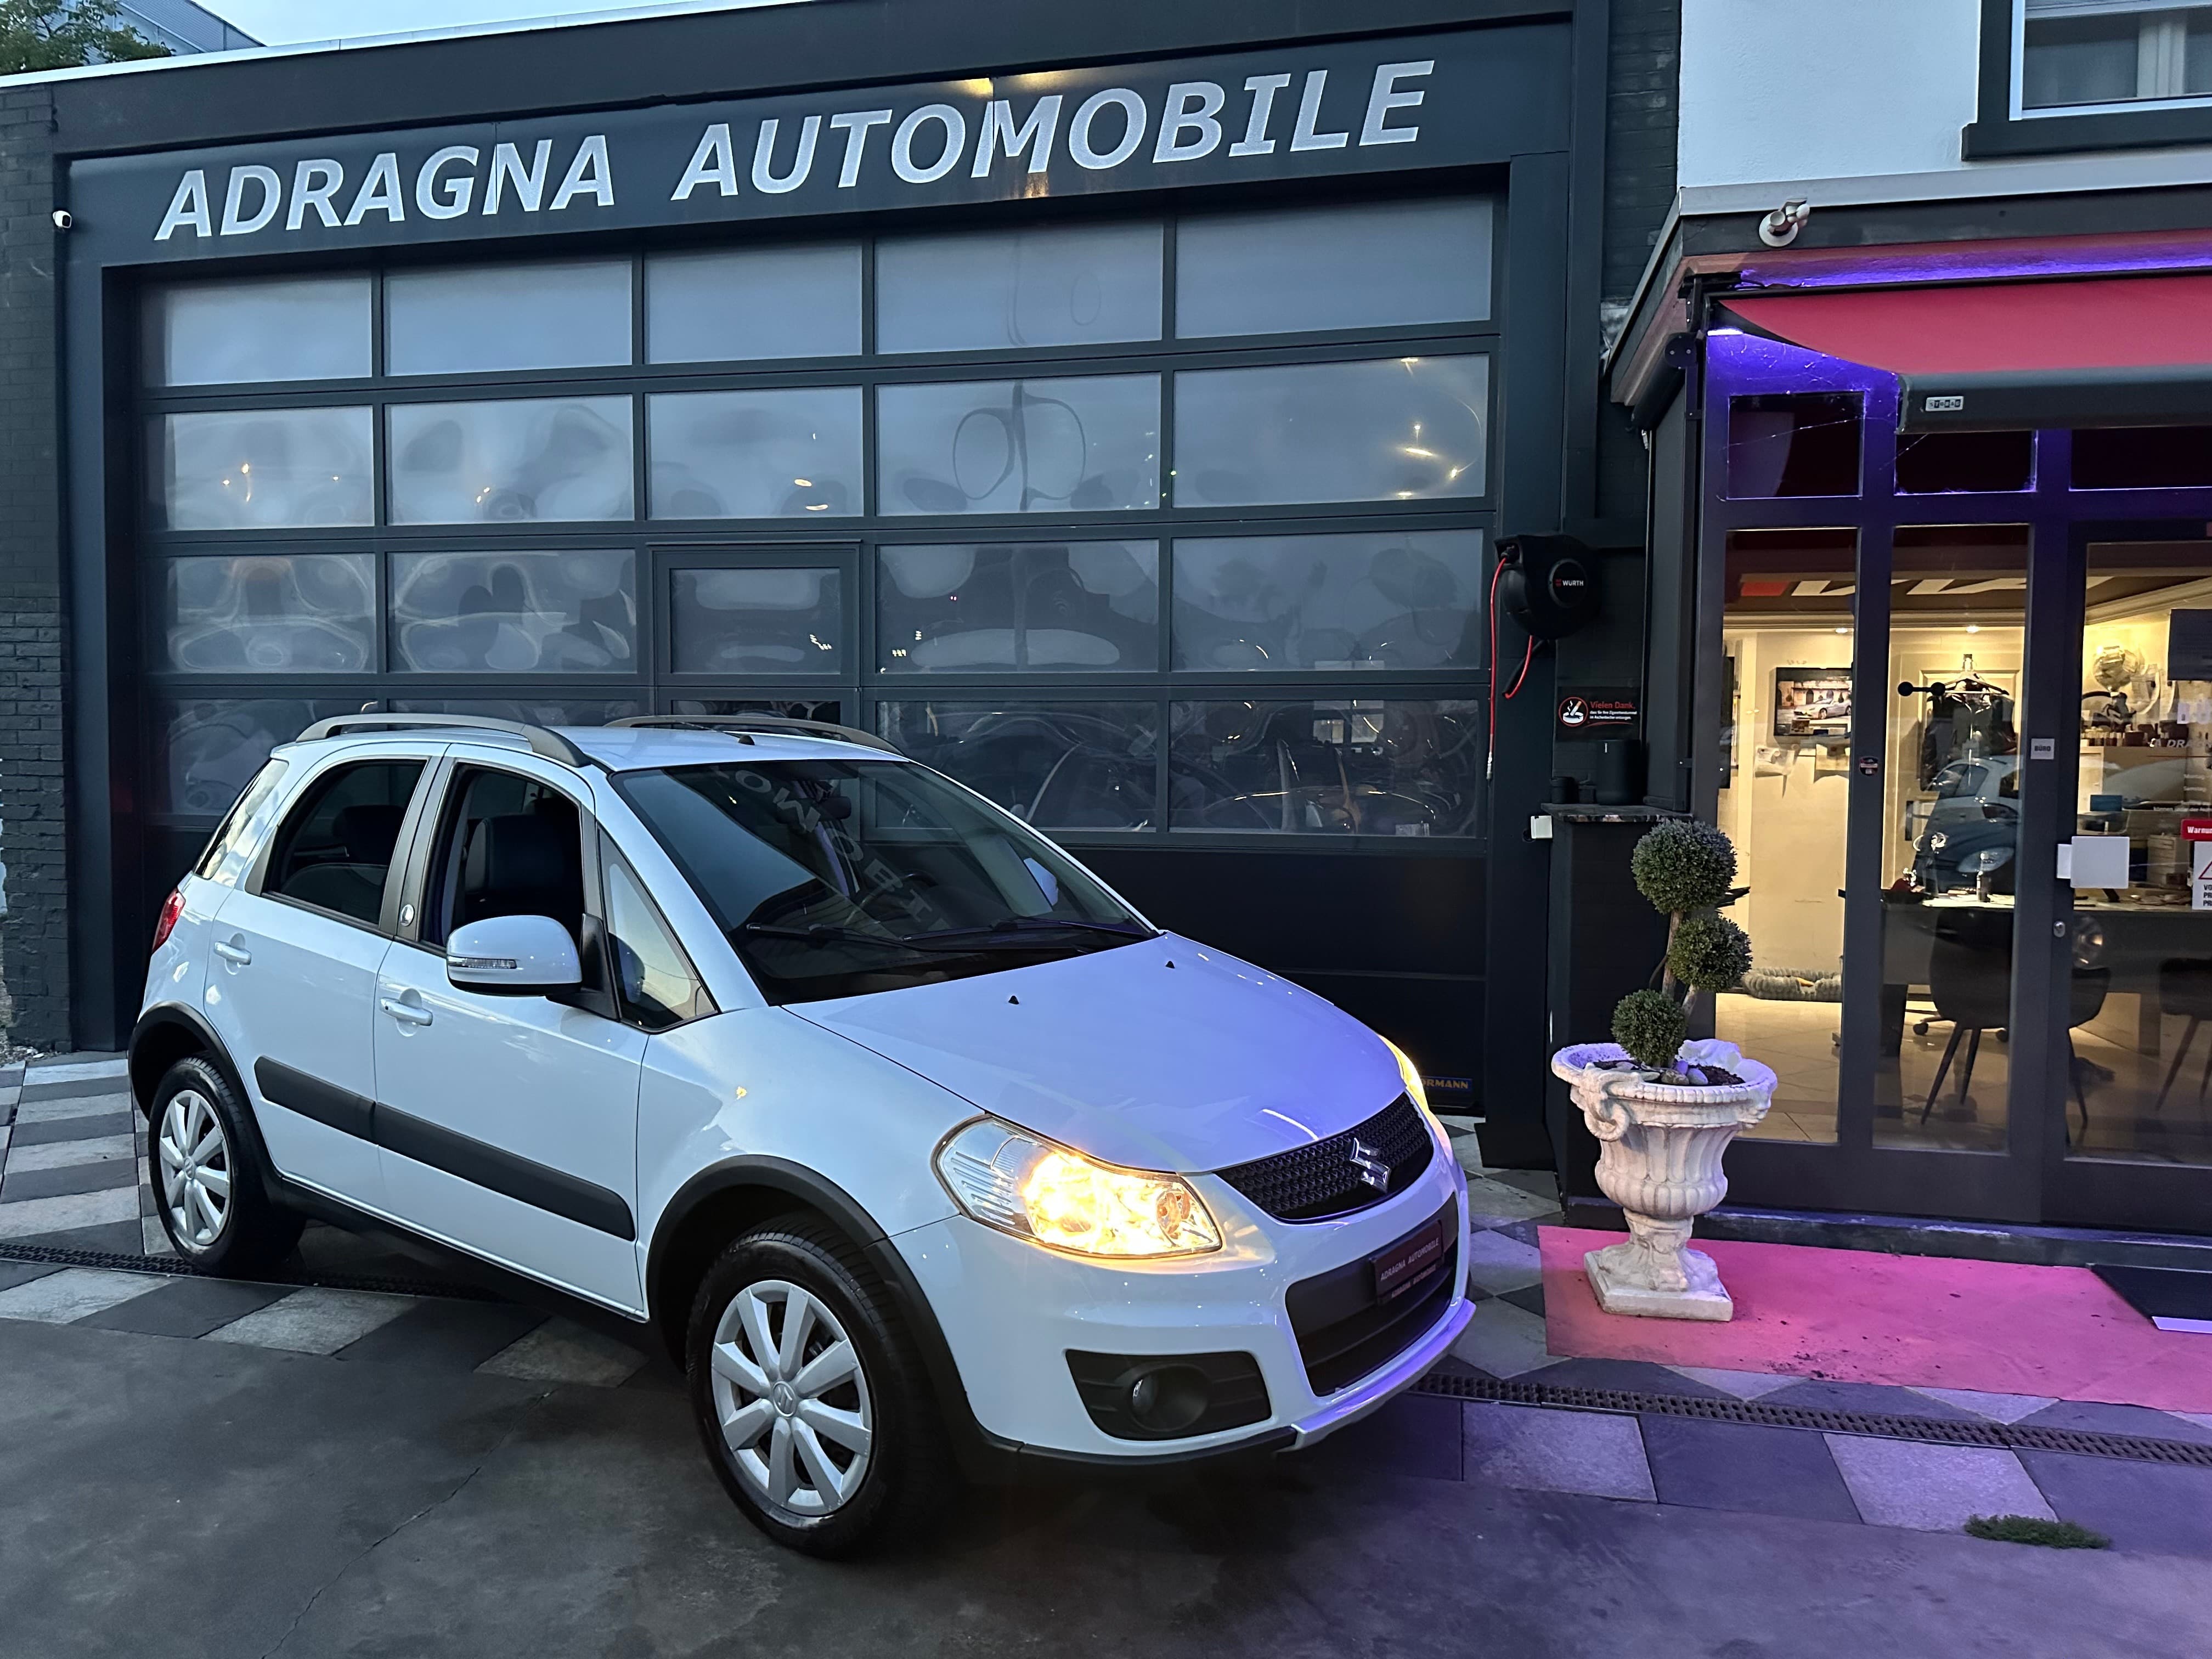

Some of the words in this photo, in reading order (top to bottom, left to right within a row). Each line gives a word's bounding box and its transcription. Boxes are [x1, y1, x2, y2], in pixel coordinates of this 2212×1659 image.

[154, 134, 614, 240] ADRAGNA
[670, 60, 1435, 201] AUTOMOBILE
[1380, 1259, 1406, 1282] ADRAGNA
[1408, 1237, 1439, 1265] AUTOMOBILE
